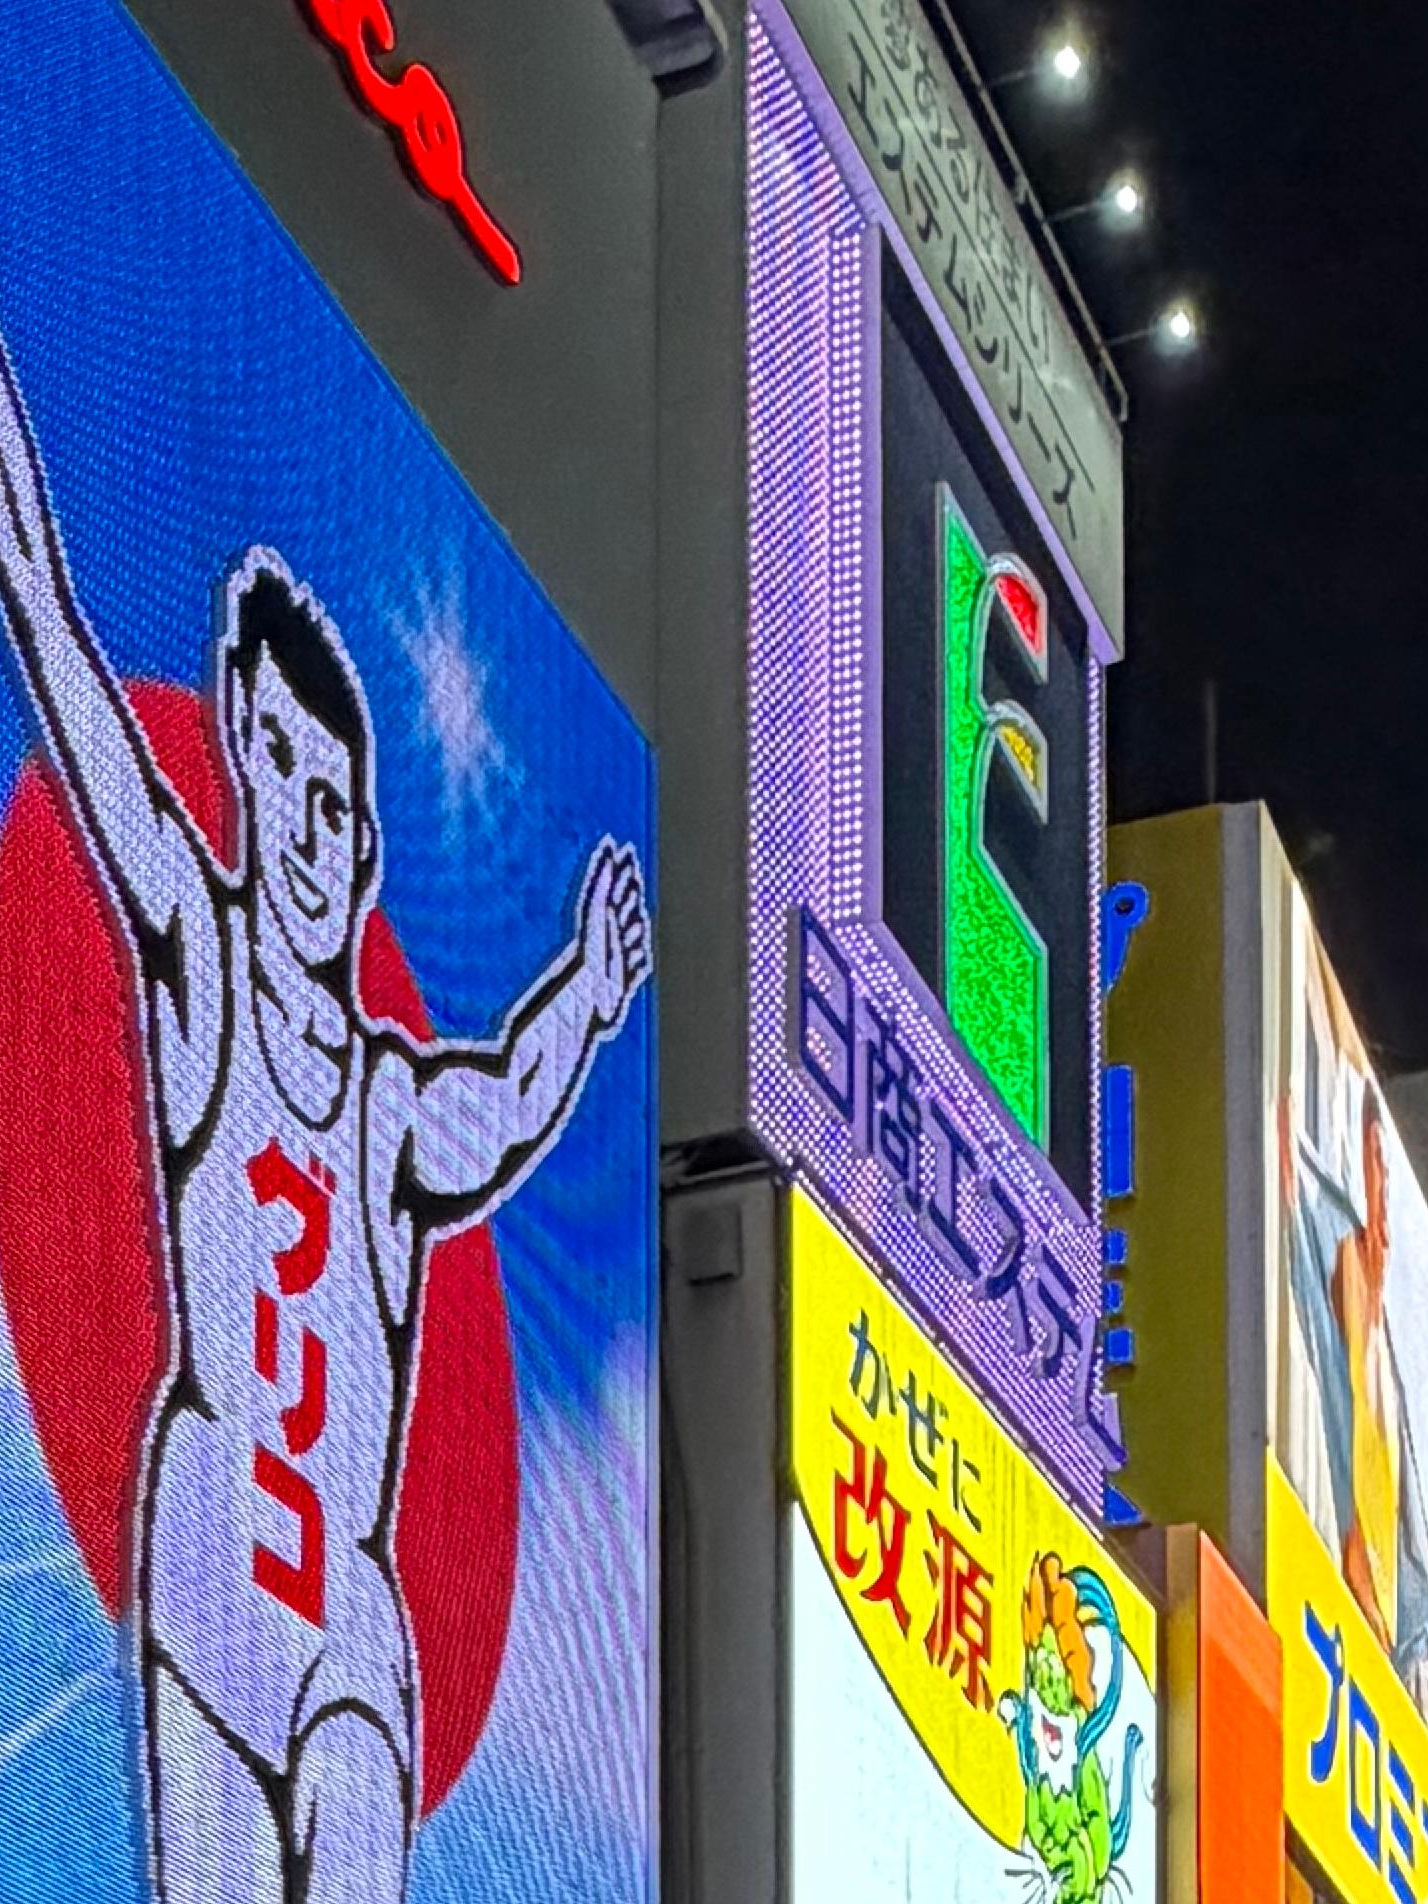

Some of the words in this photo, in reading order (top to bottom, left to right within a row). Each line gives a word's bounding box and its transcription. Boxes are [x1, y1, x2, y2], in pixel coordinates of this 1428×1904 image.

[246, 1136, 336, 1632] グリコ
[848, 1306, 984, 1534] かぜに
[830, 1407, 997, 1715] 改源
